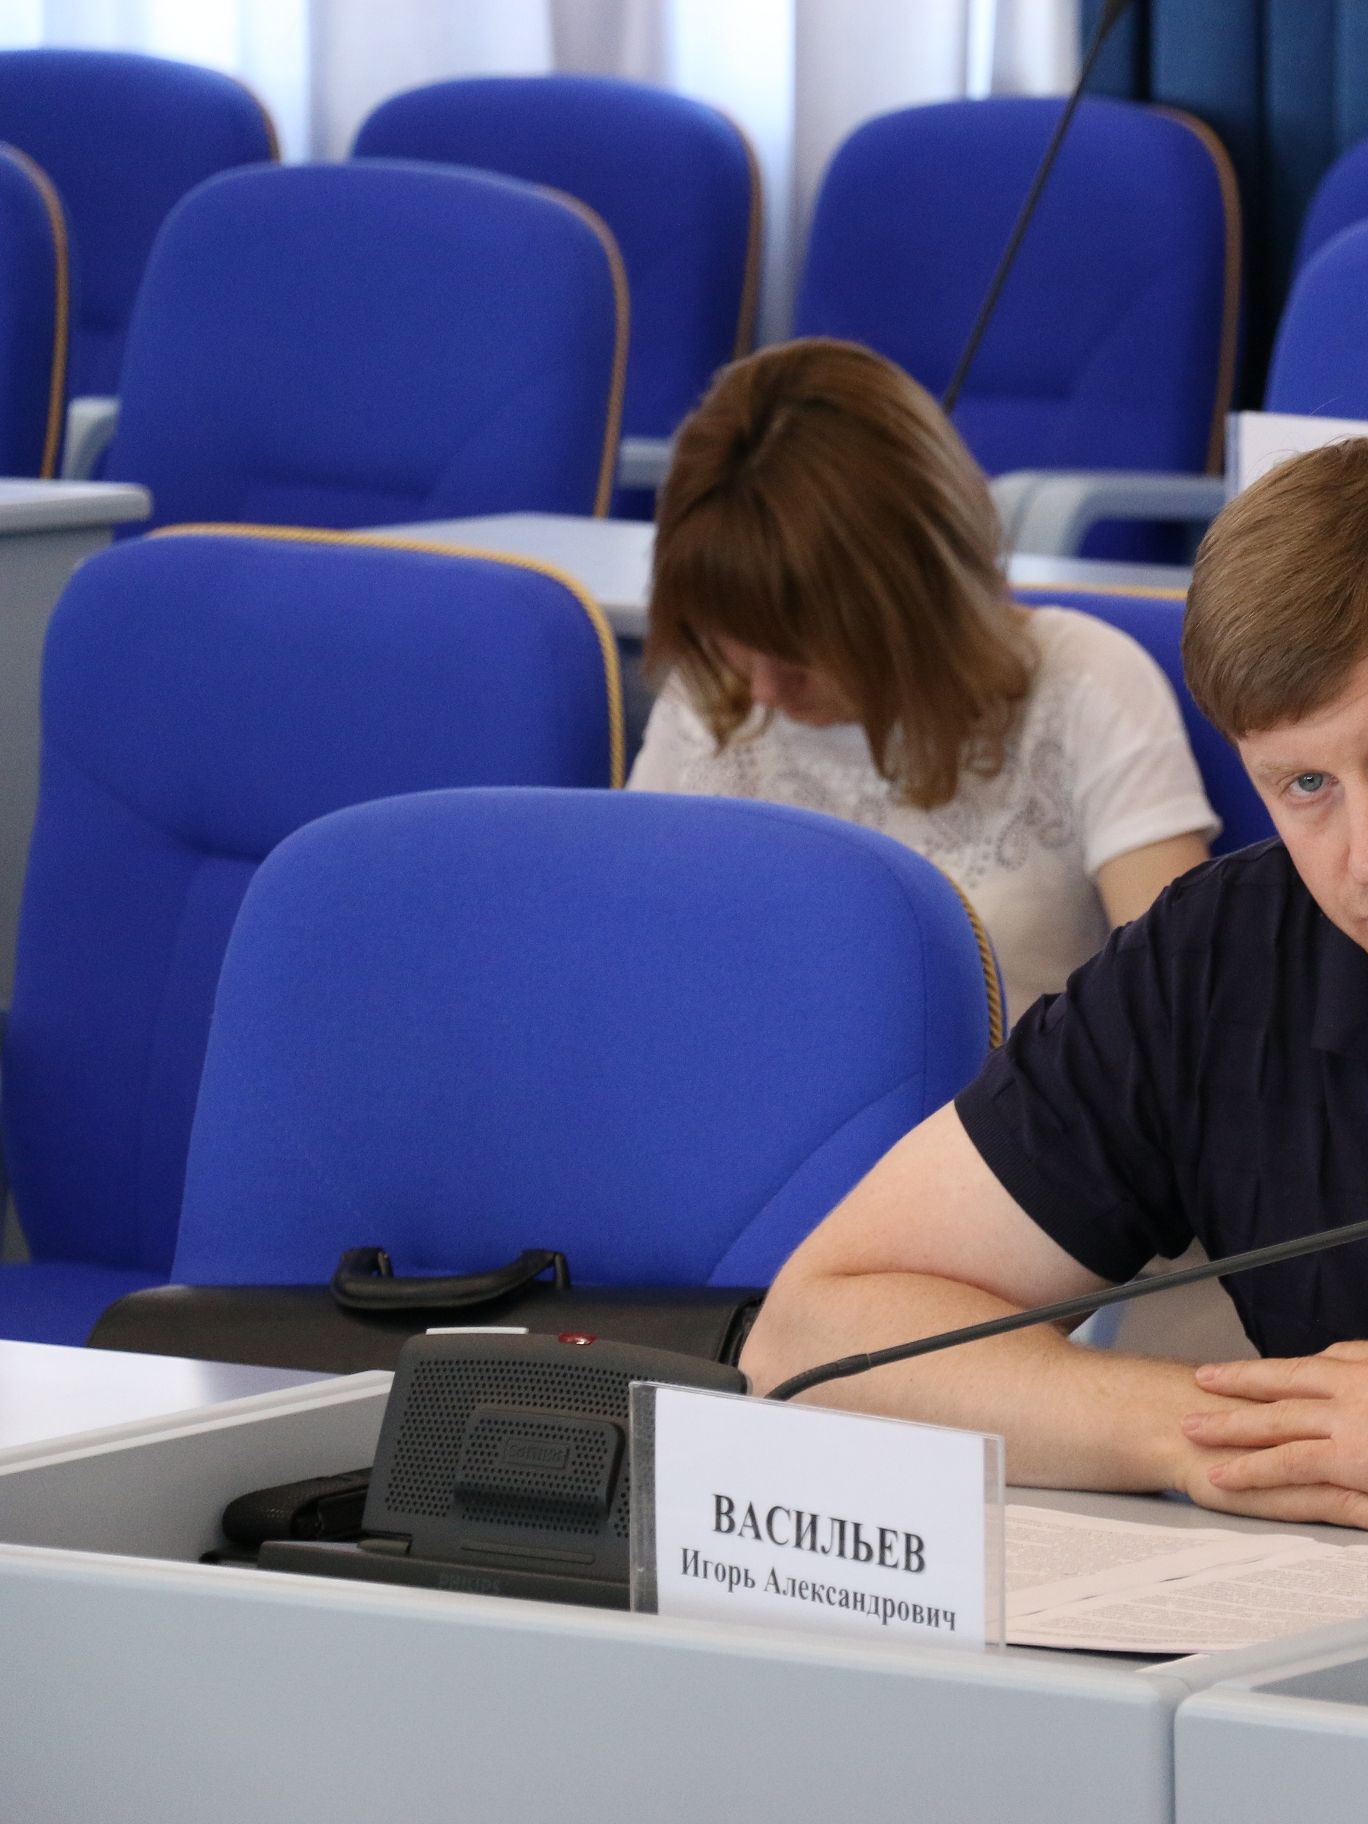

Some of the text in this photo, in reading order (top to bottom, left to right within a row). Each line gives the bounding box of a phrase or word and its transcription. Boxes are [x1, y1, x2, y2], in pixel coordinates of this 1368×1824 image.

[712, 1494, 926, 1574] ВАСИЛЬЕВ
[681, 1547, 756, 1593] Игорь
[764, 1567, 957, 1631] Александрович
